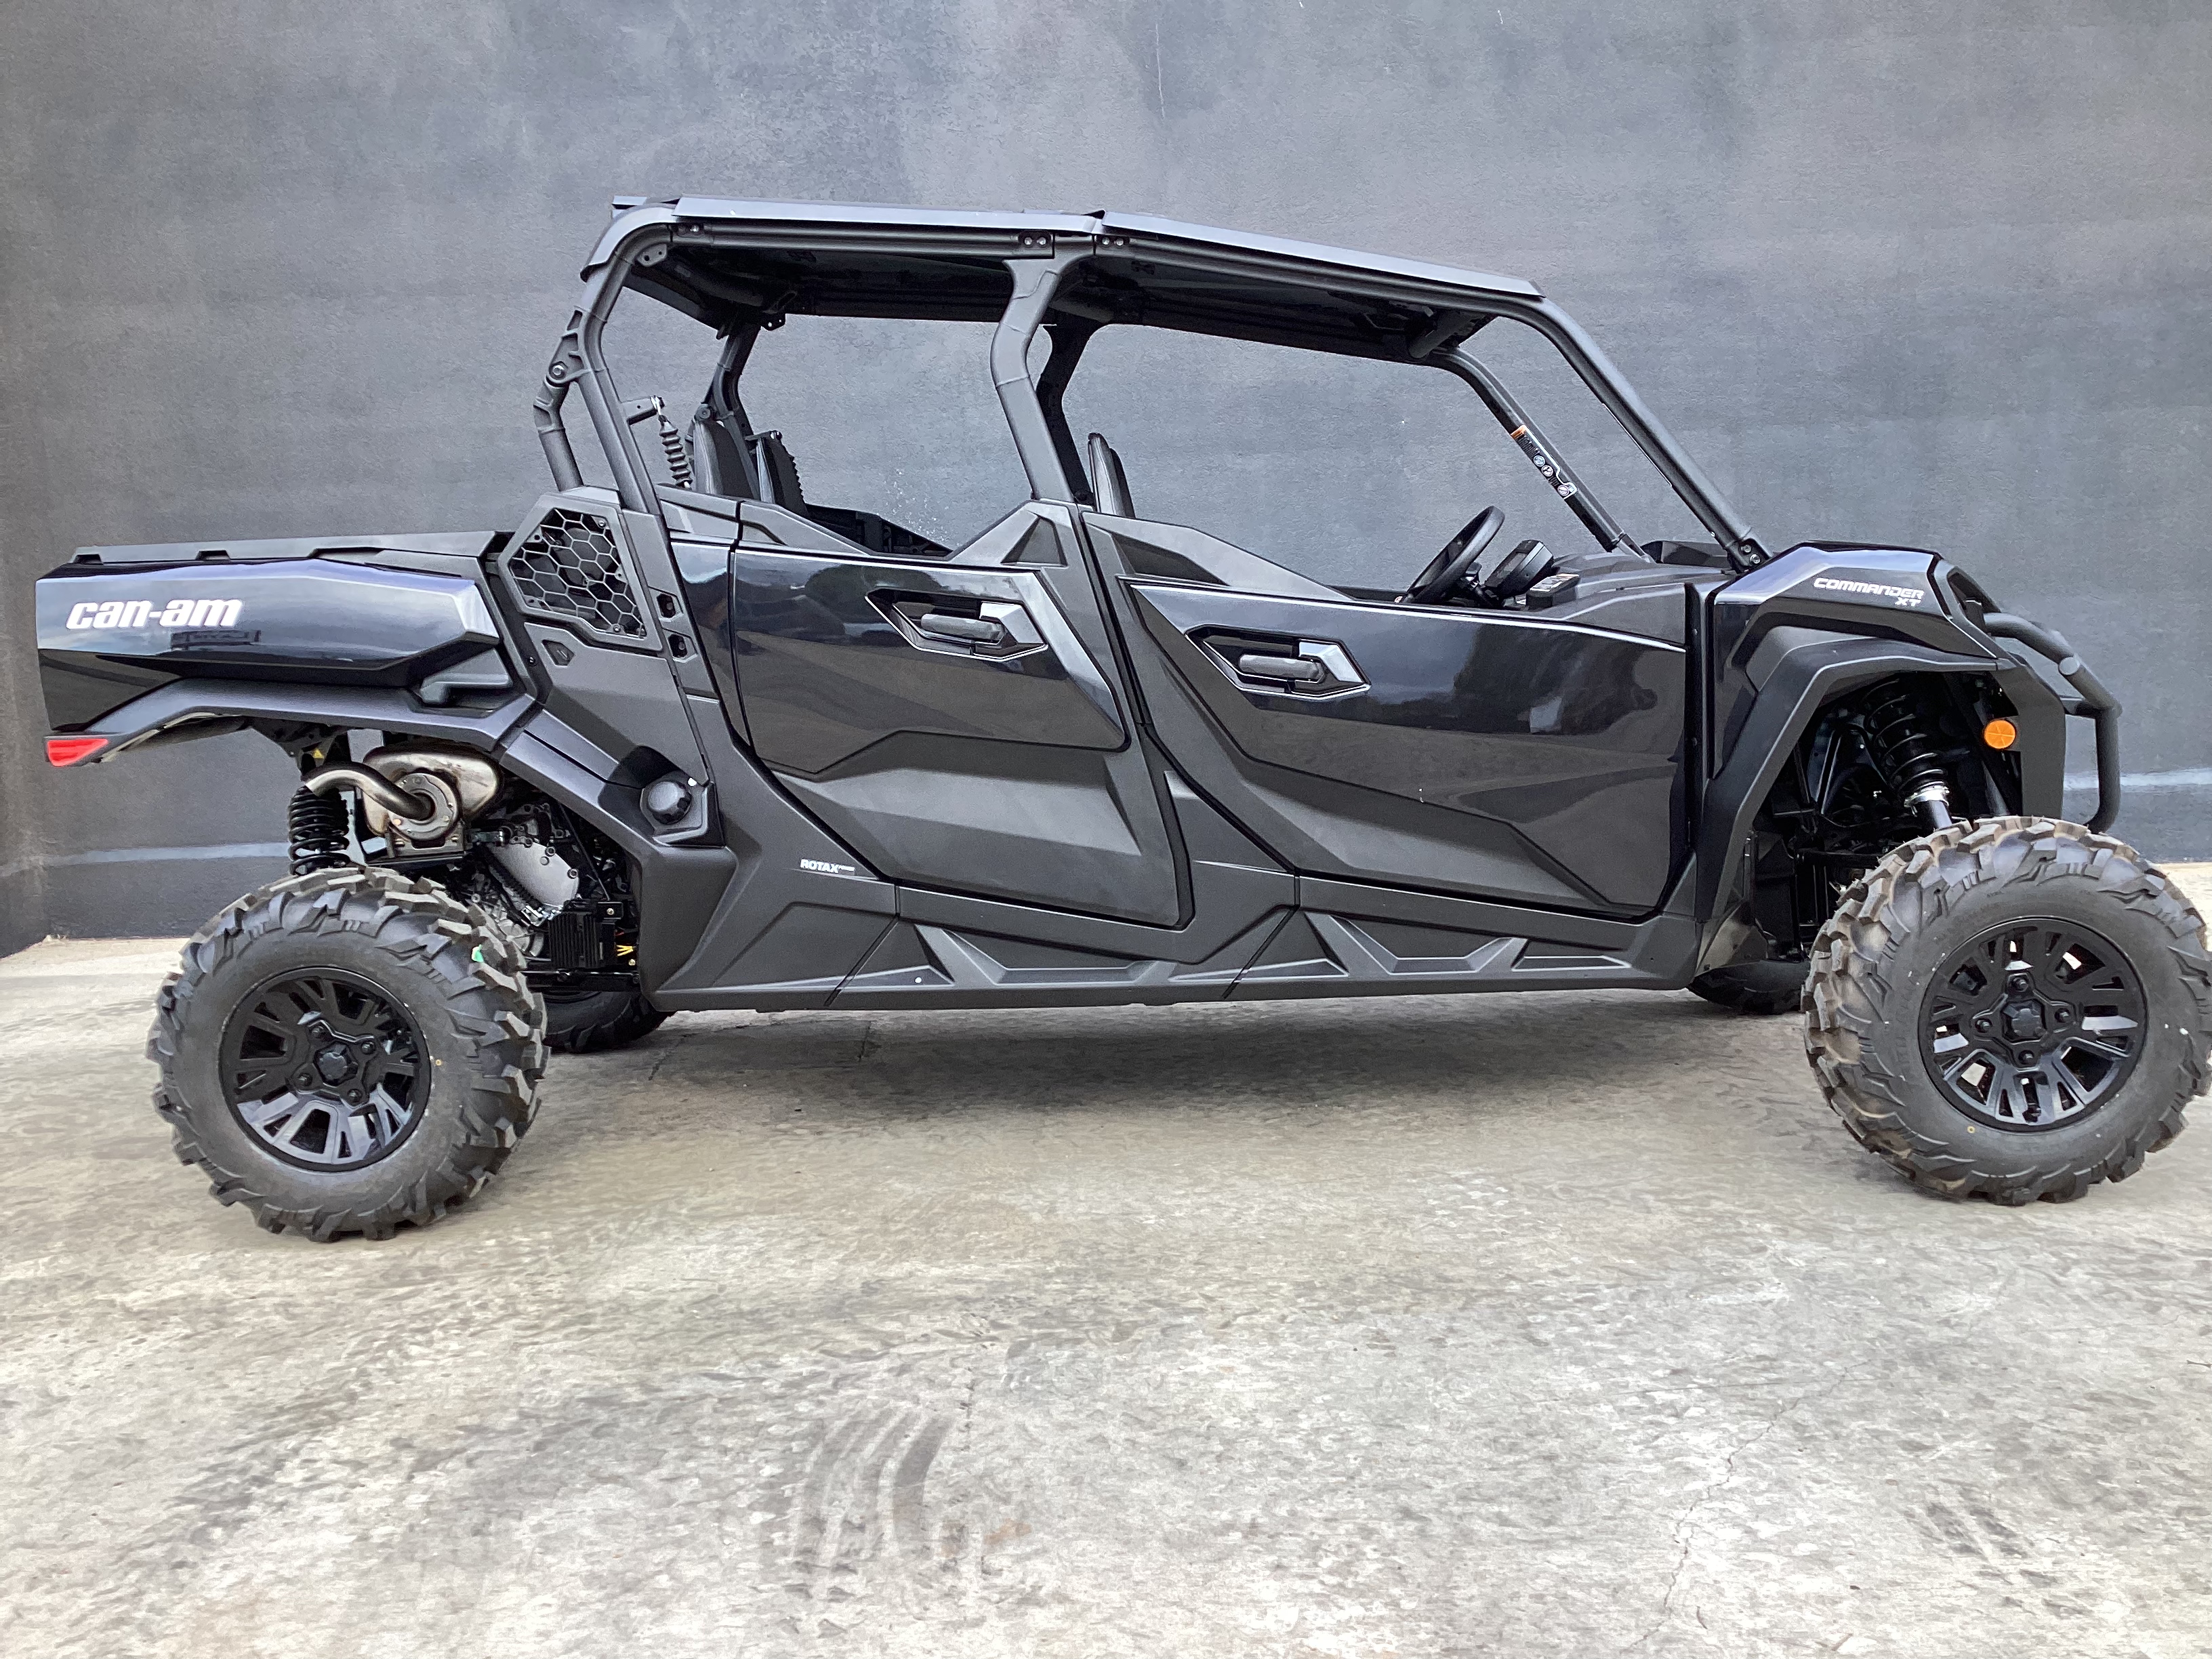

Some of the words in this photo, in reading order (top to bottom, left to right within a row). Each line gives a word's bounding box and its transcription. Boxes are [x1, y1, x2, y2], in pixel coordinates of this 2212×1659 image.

[1814, 577, 1925, 599] COMMANDER
[1895, 597, 1921, 607] XT
[66, 599, 243, 630] can-am
[800, 859, 839, 874] ROTAX
